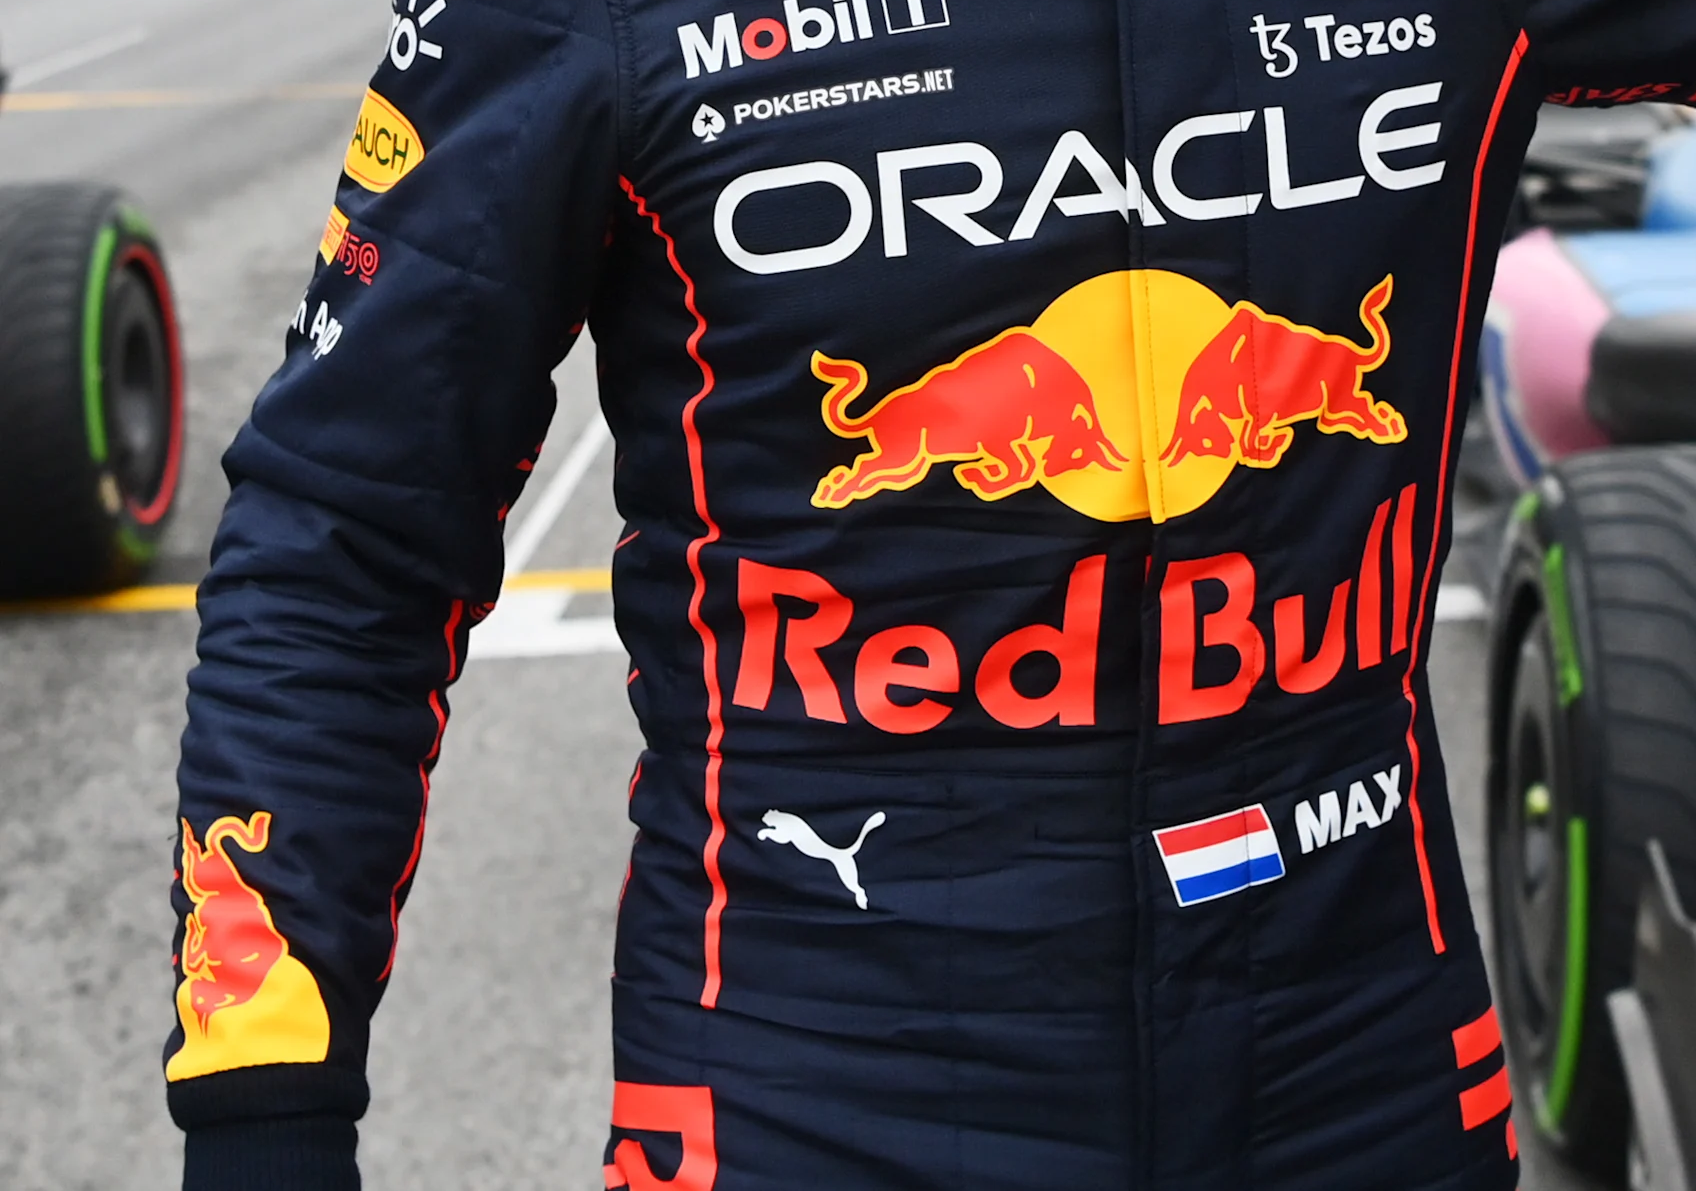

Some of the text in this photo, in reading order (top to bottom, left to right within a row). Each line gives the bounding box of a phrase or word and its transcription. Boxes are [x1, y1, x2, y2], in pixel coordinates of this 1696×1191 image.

[1303, 13, 1437, 62] Tezos
[733, 68, 955, 126] POKERSTARS.NET
[713, 81, 1447, 275] ORACLE
[732, 483, 1418, 735] Red Bull
[1294, 763, 1404, 854] MAX
